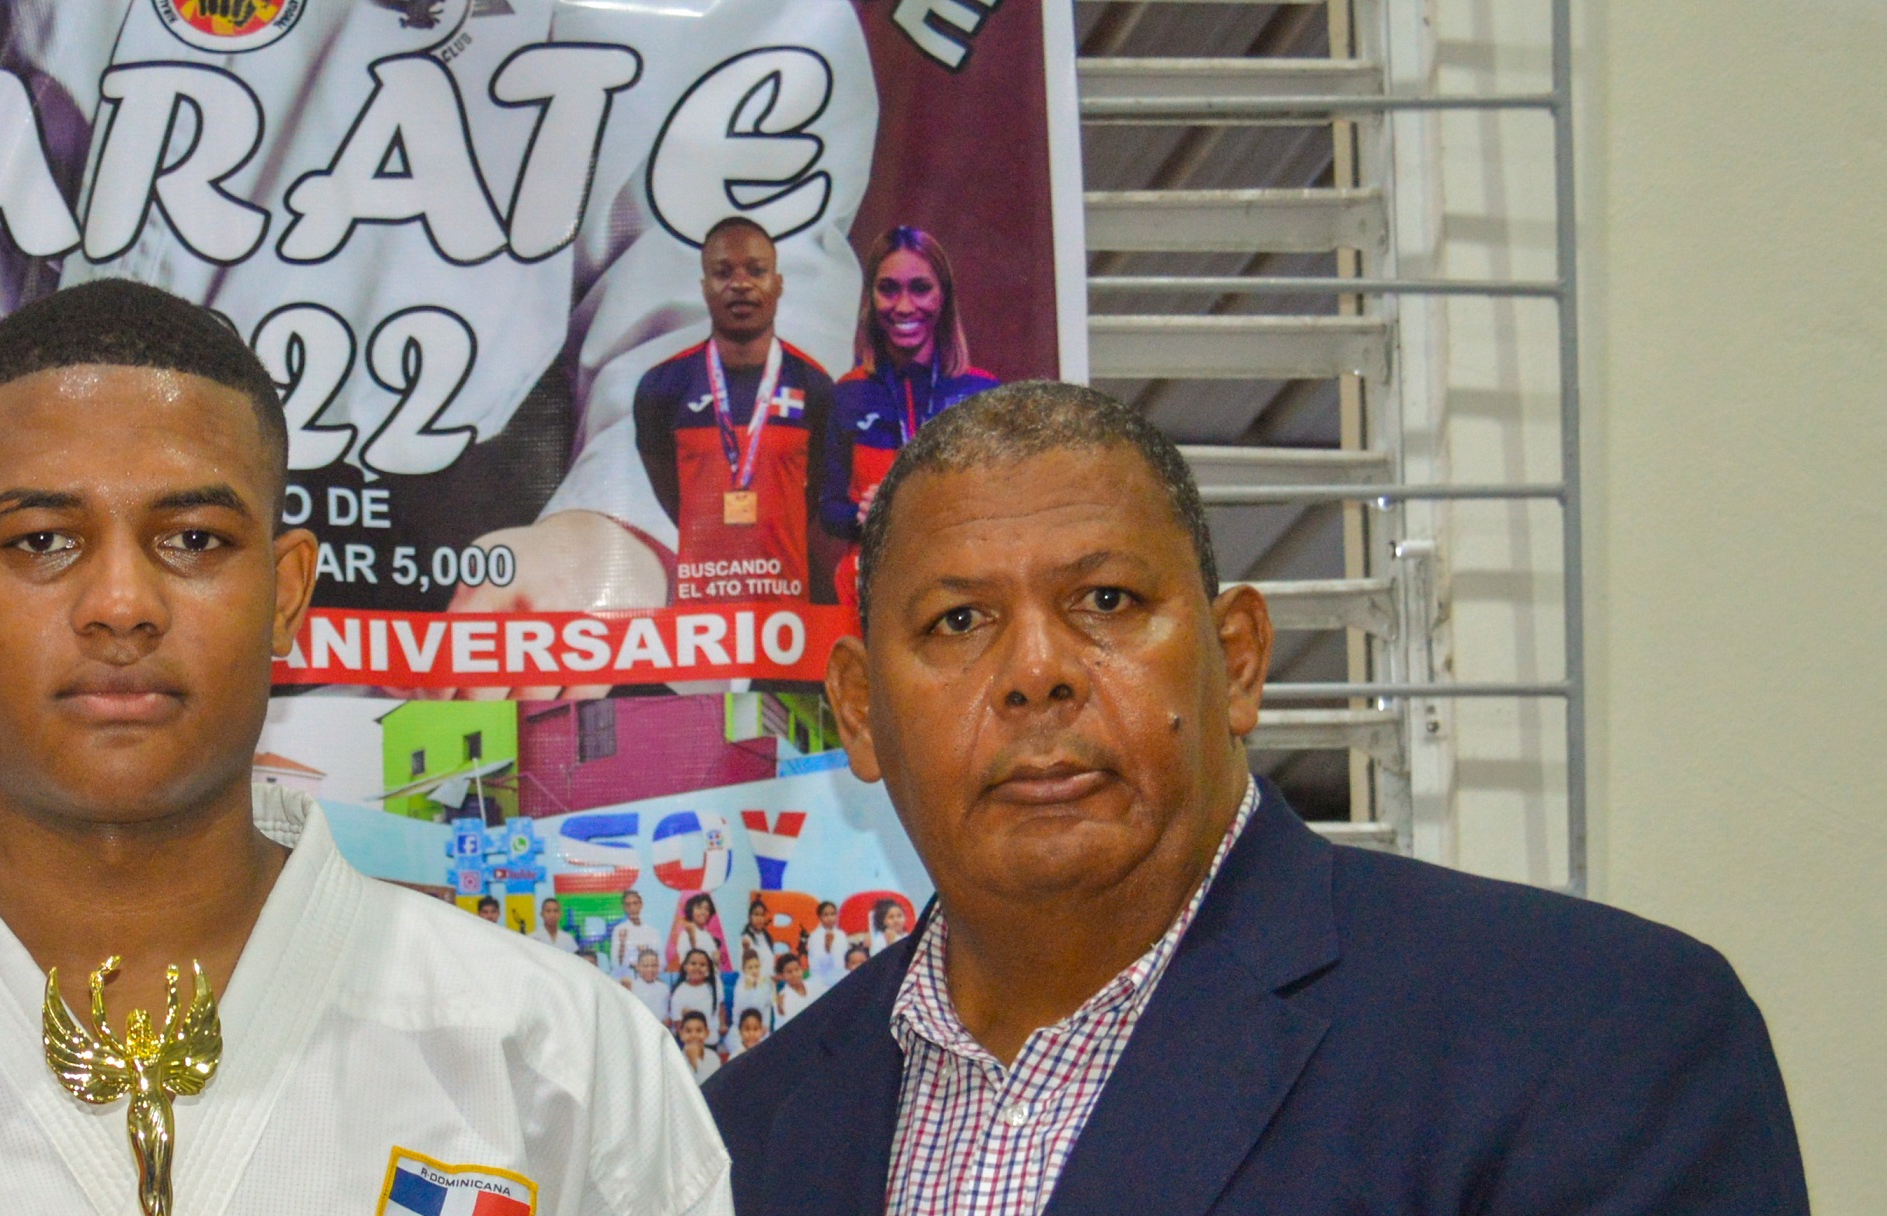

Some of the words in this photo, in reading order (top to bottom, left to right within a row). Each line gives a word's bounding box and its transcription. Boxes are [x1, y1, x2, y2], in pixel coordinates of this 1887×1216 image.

[327, 486, 391, 528] DE
[392, 544, 516, 593] 5,000
[677, 558, 782, 579] BUSCANDO
[678, 583, 702, 599] EL
[705, 580, 742, 597] 4TO
[745, 578, 802, 596] TITULO
